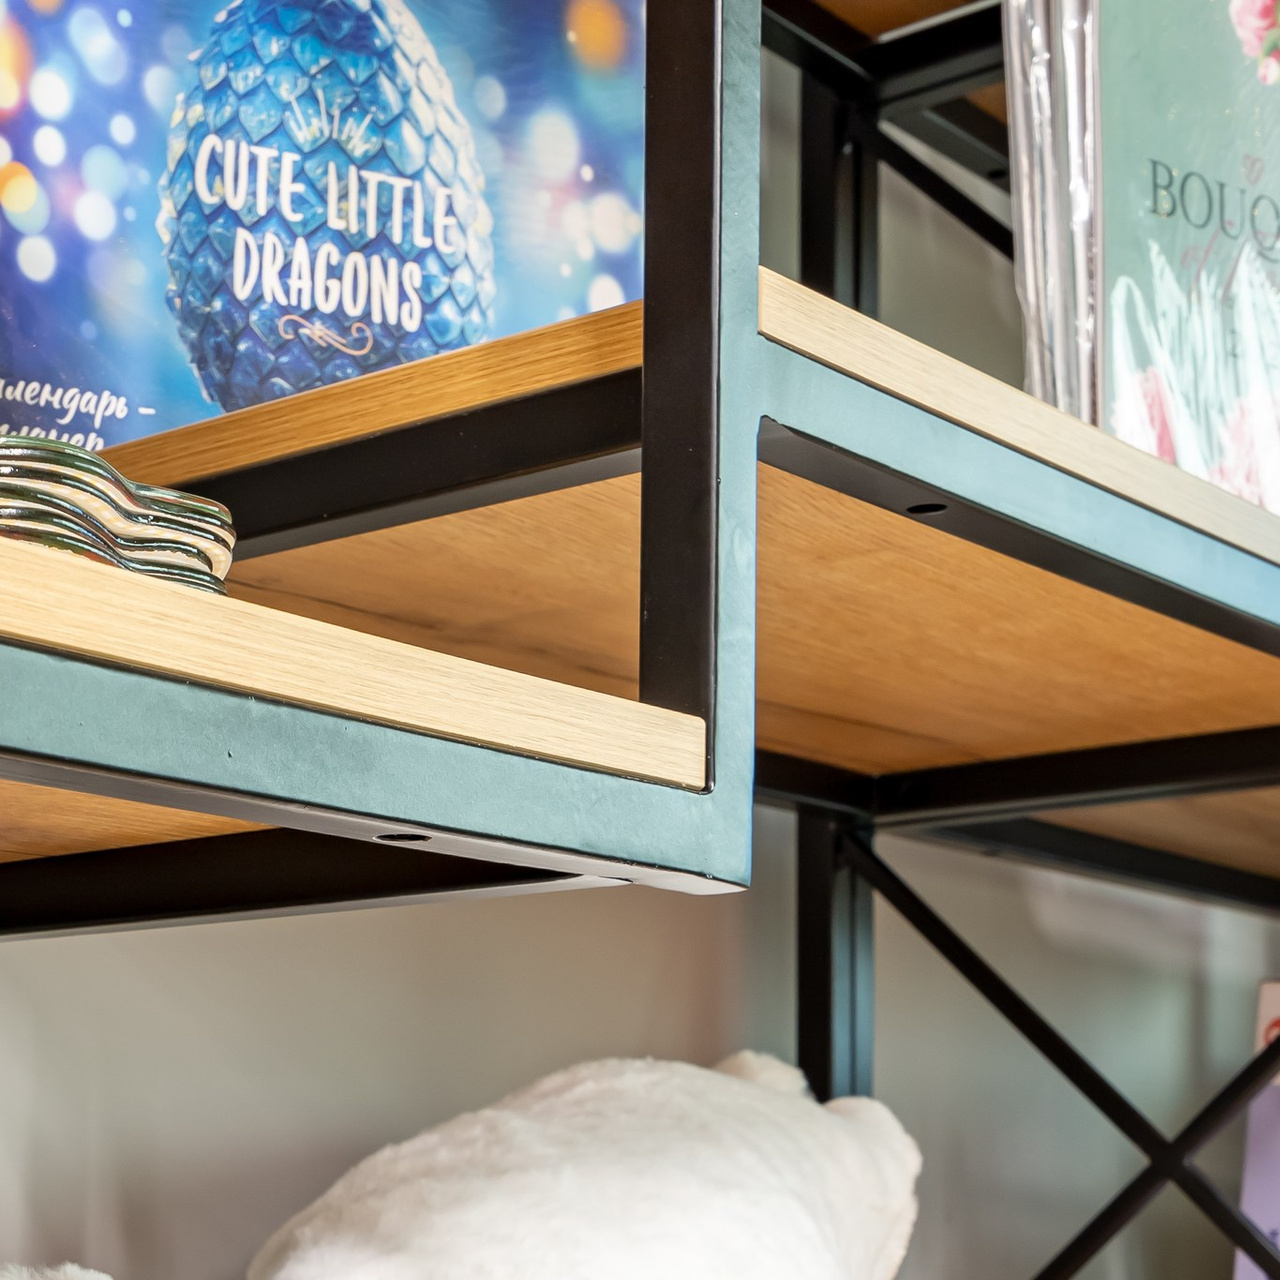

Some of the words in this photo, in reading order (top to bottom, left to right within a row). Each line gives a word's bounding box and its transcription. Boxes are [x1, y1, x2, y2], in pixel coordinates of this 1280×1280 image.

[195, 134, 305, 222] CUTE
[327, 160, 458, 253] LITTLE
[1149, 158, 1280, 263] BOUQ
[233, 226, 421, 333] DRAGONS
